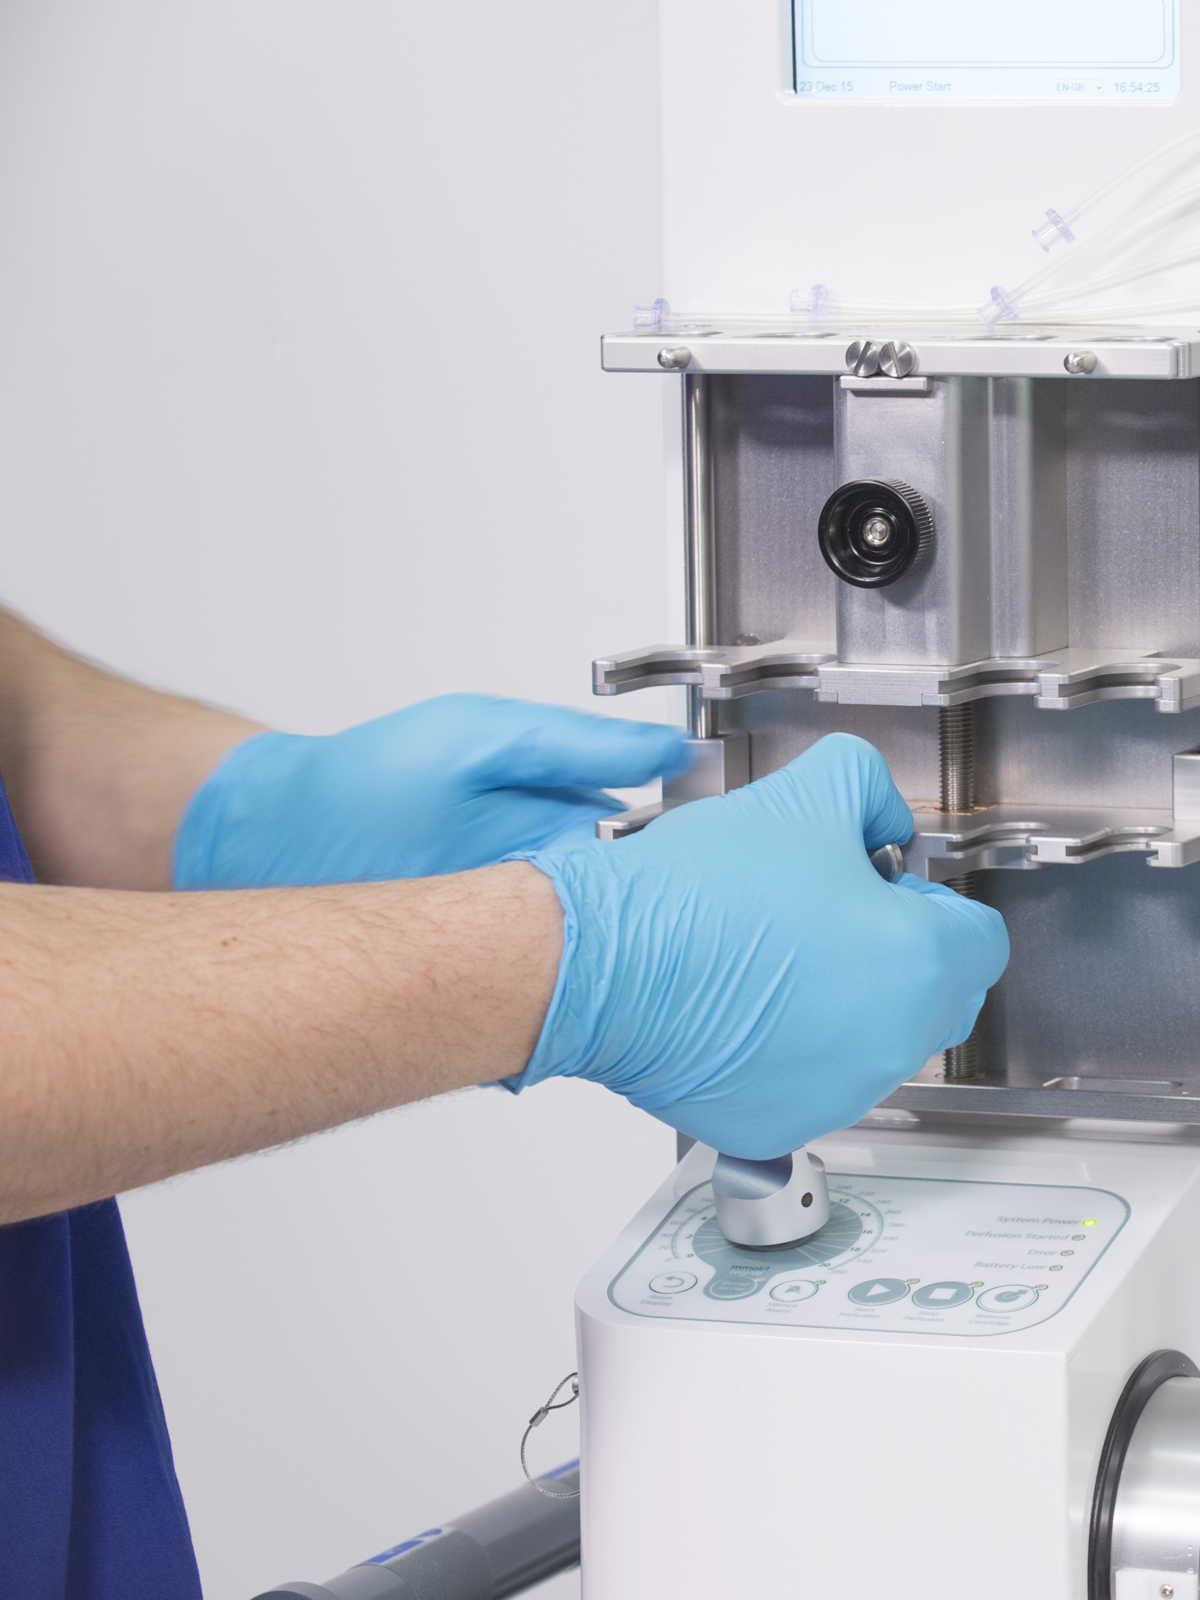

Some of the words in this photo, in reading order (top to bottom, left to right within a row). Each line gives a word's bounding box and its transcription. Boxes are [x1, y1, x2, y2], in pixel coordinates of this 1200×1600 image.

[816, 81, 838, 92] Dec
[889, 81, 923, 92] Power
[926, 81, 952, 92] Start
[997, 1215, 1040, 1224] System
